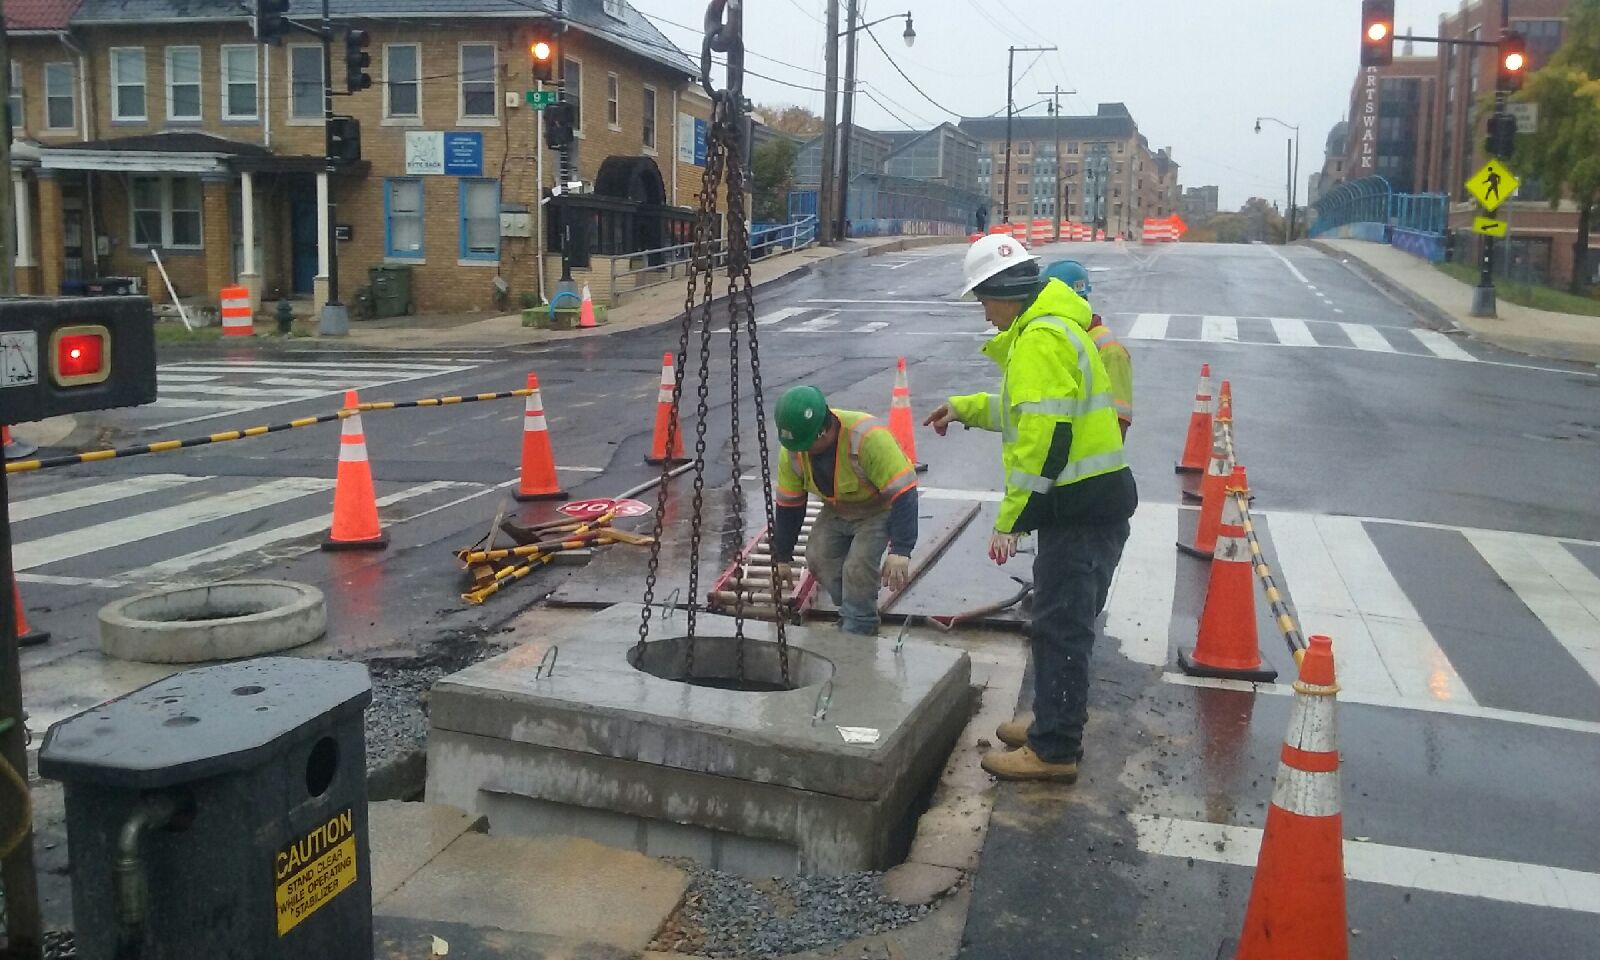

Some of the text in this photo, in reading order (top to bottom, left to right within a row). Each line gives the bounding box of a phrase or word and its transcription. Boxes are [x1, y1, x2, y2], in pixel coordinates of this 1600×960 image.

[277, 809, 353, 880] CAUTION
[280, 856, 352, 915] WHILE OPERATING
[287, 848, 344, 895] STAND CLEAR
[295, 878, 340, 918] STABILIZER
